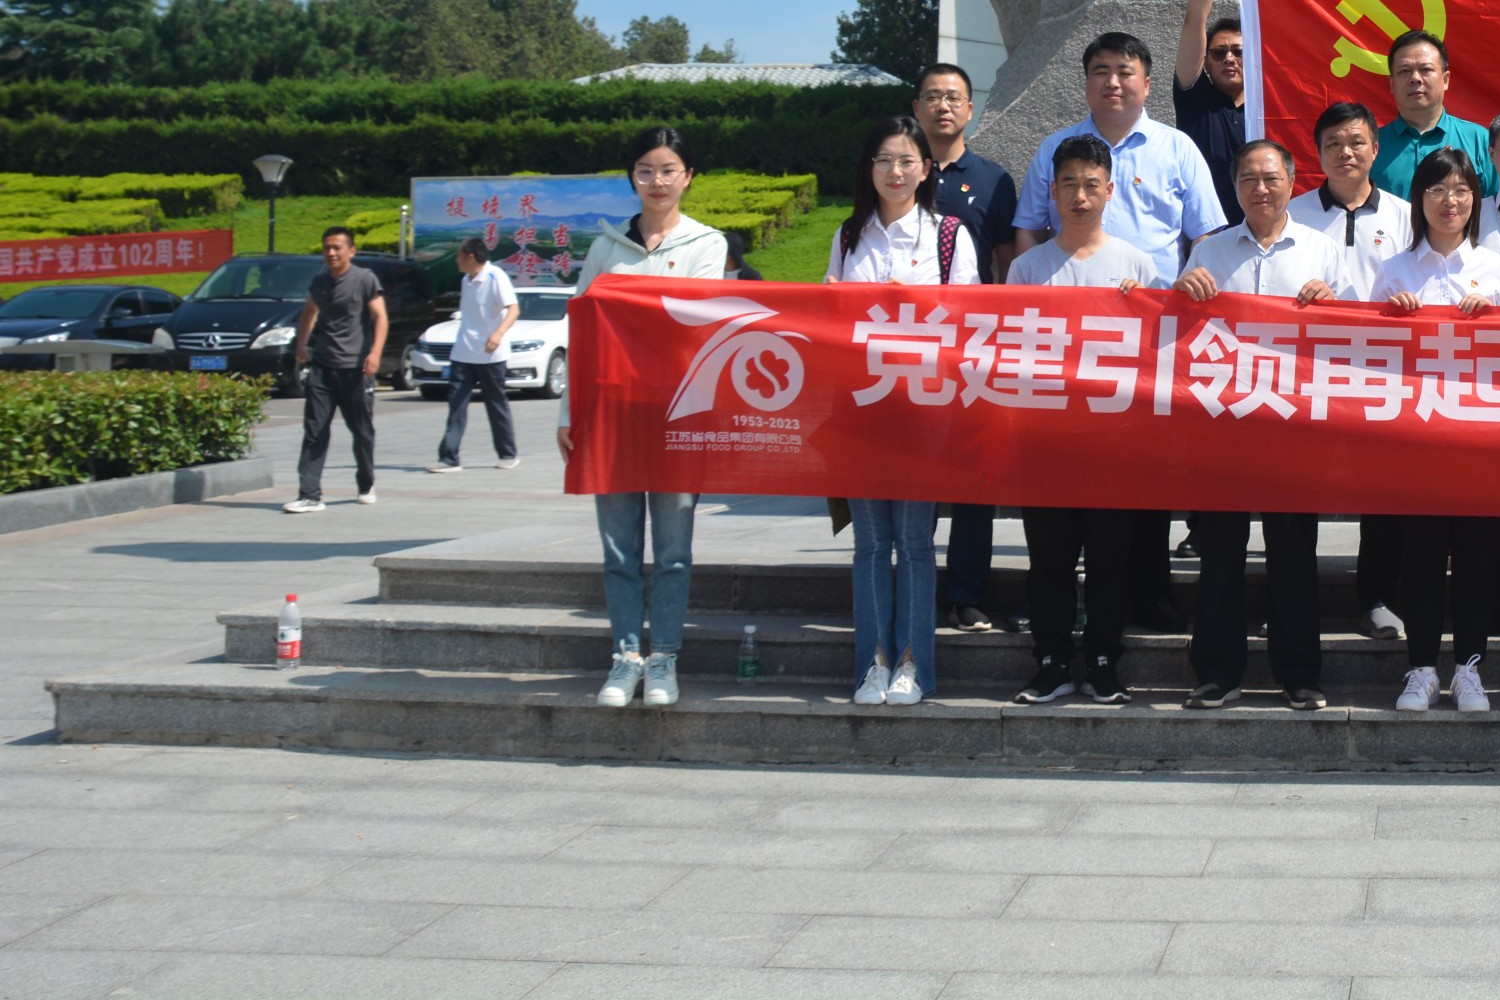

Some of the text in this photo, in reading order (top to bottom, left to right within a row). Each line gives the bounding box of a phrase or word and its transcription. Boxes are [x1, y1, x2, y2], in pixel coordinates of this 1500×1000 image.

[732, 415, 800, 430] 1953-2023
[665, 431, 802, 445] 江苏省食品集团有限公司
[665, 443, 703, 451] JIANGSU
